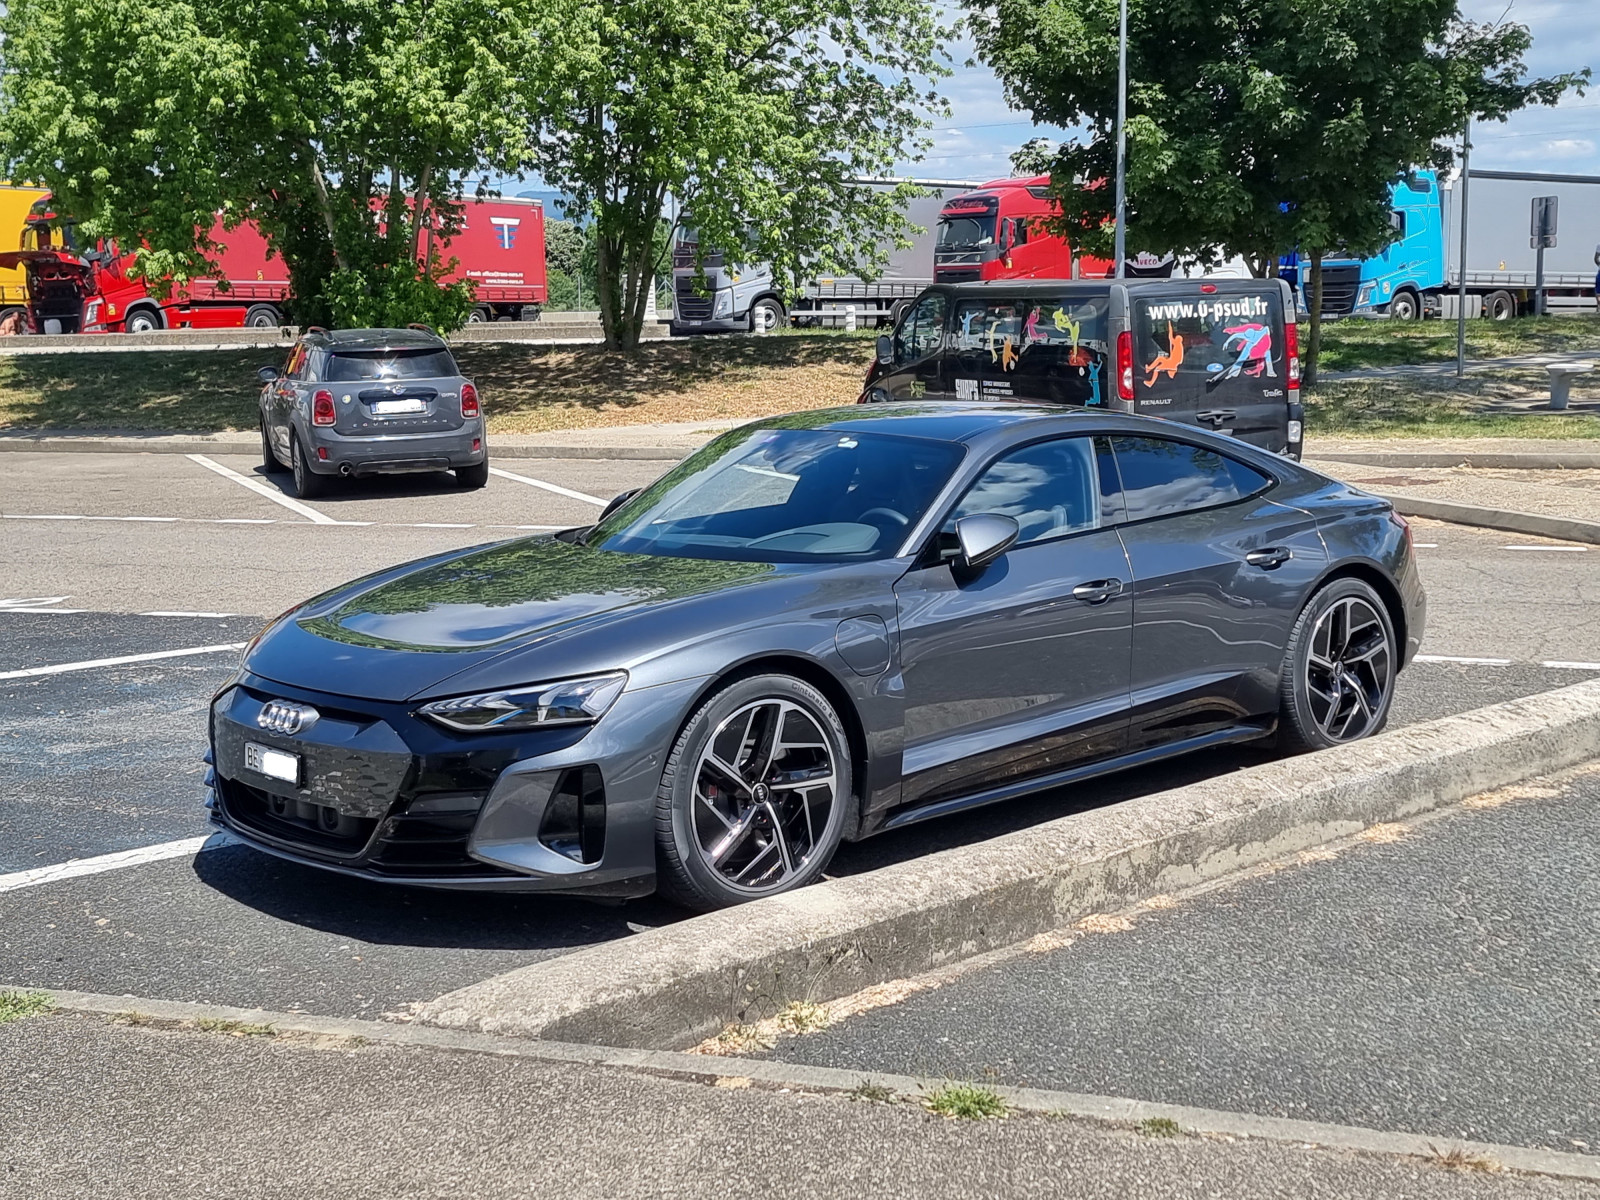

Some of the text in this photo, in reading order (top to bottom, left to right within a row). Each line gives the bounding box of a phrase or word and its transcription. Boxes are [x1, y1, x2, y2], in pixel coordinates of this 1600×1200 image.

[1136, 258, 1158, 266] IVECO
[1148, 296, 1268, 322] www.u-psud.fr
[1140, 398, 1172, 406] RENAULT
